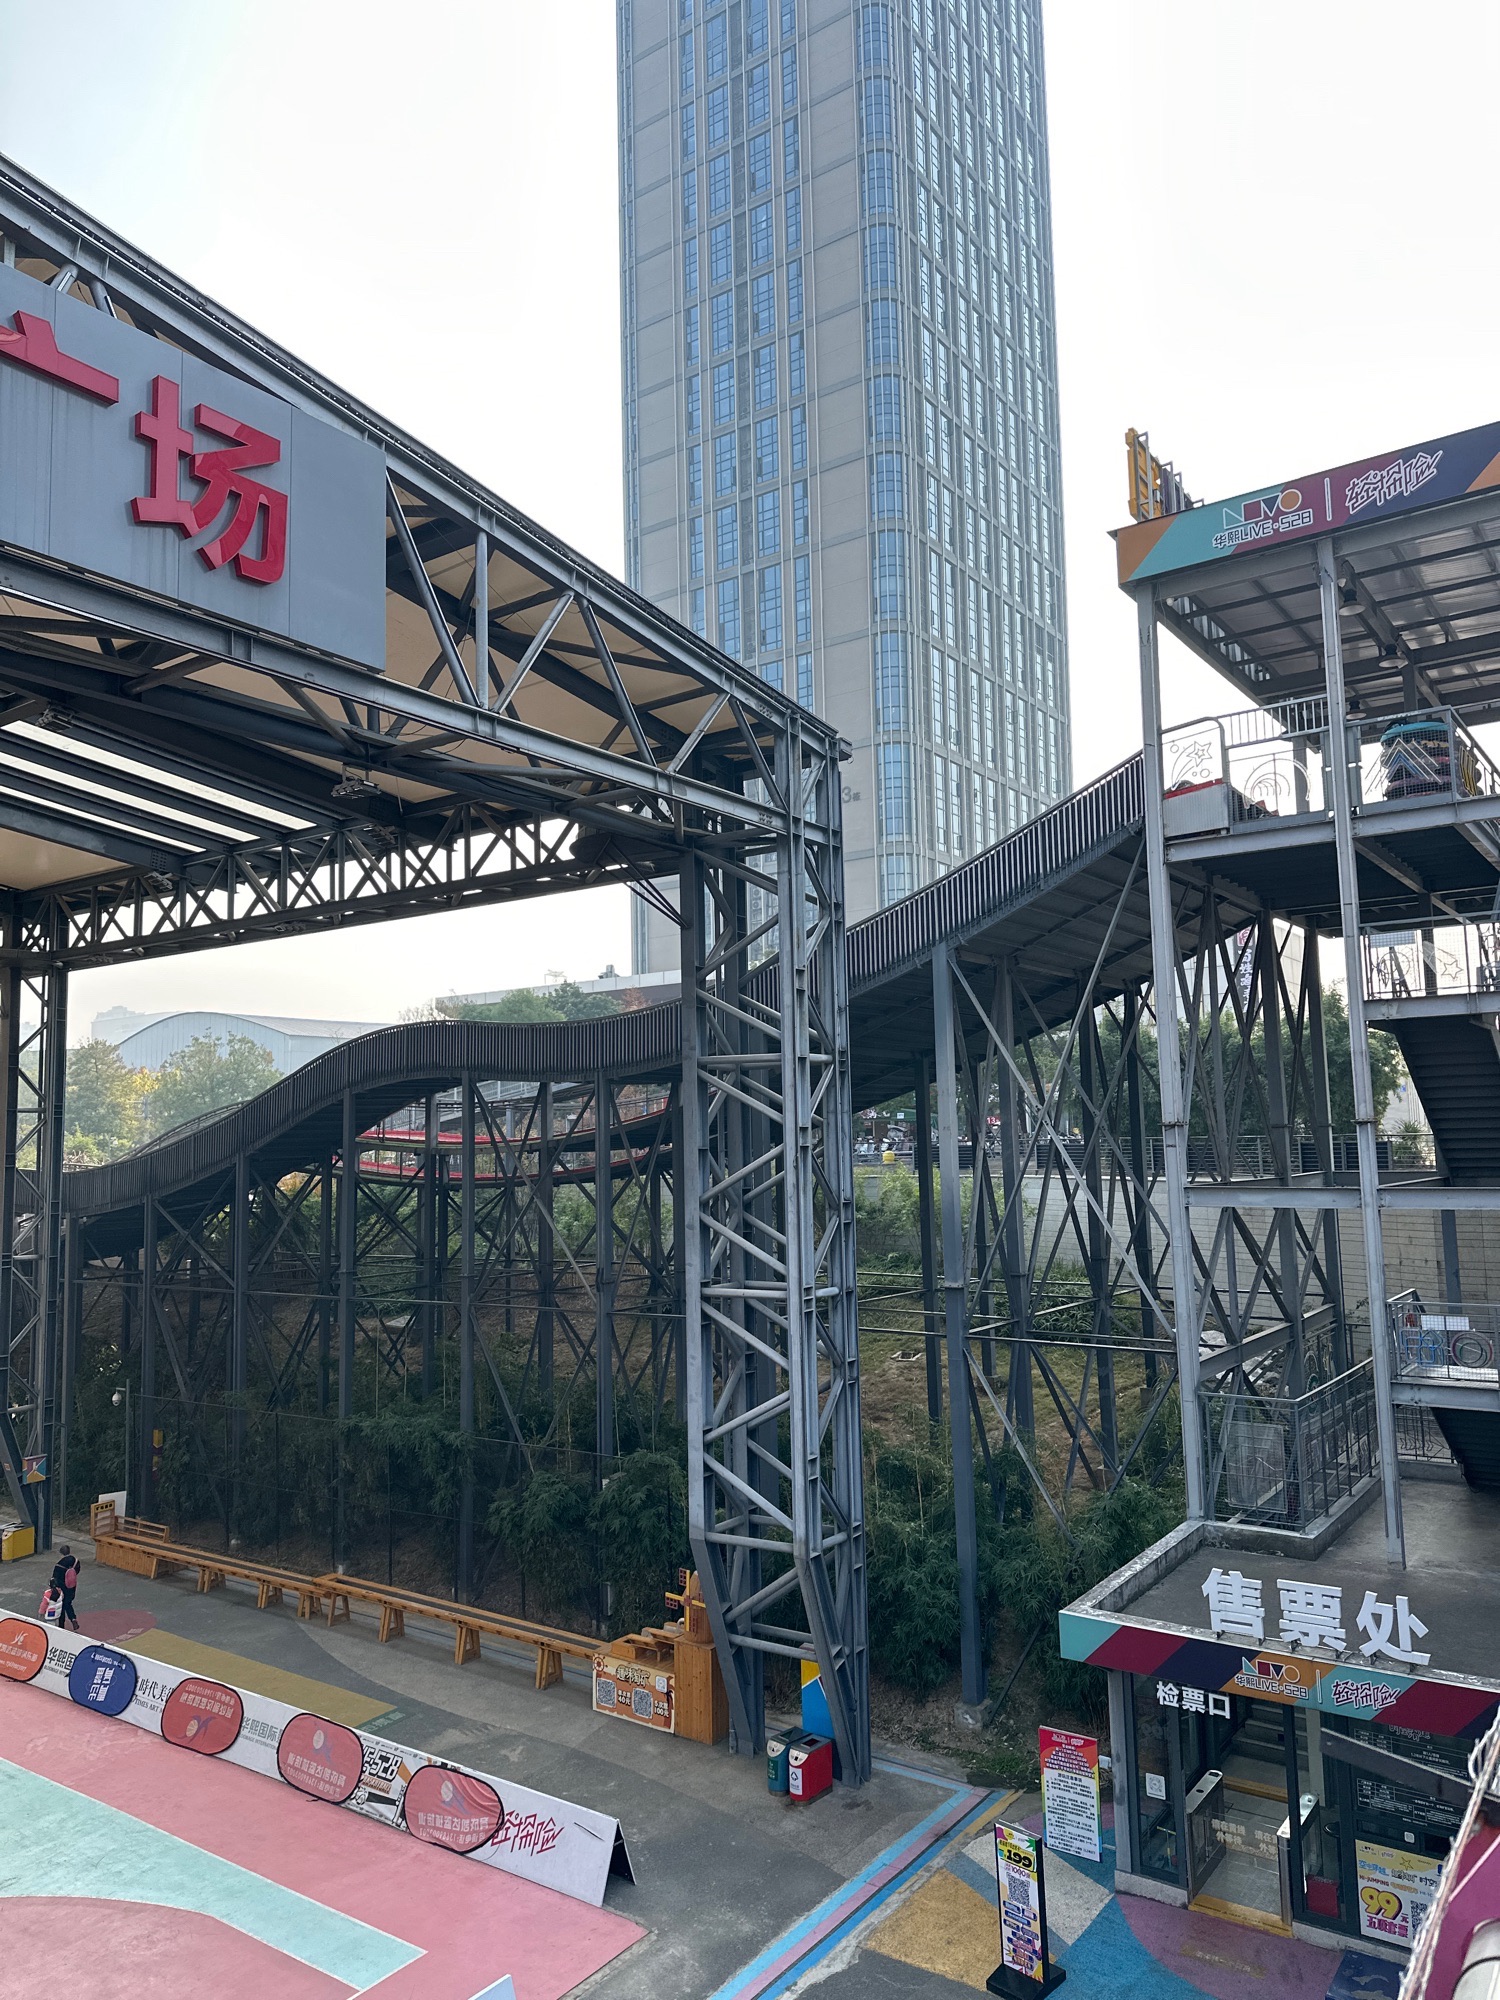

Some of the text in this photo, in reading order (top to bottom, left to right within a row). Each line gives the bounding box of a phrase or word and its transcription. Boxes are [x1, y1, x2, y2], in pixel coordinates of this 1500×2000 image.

[1201, 1567, 1431, 1666] 售票处
[1156, 1680, 1231, 1720] 检票口
[1006, 1849, 1033, 1869] 199
[1360, 1885, 1402, 1921] 99
